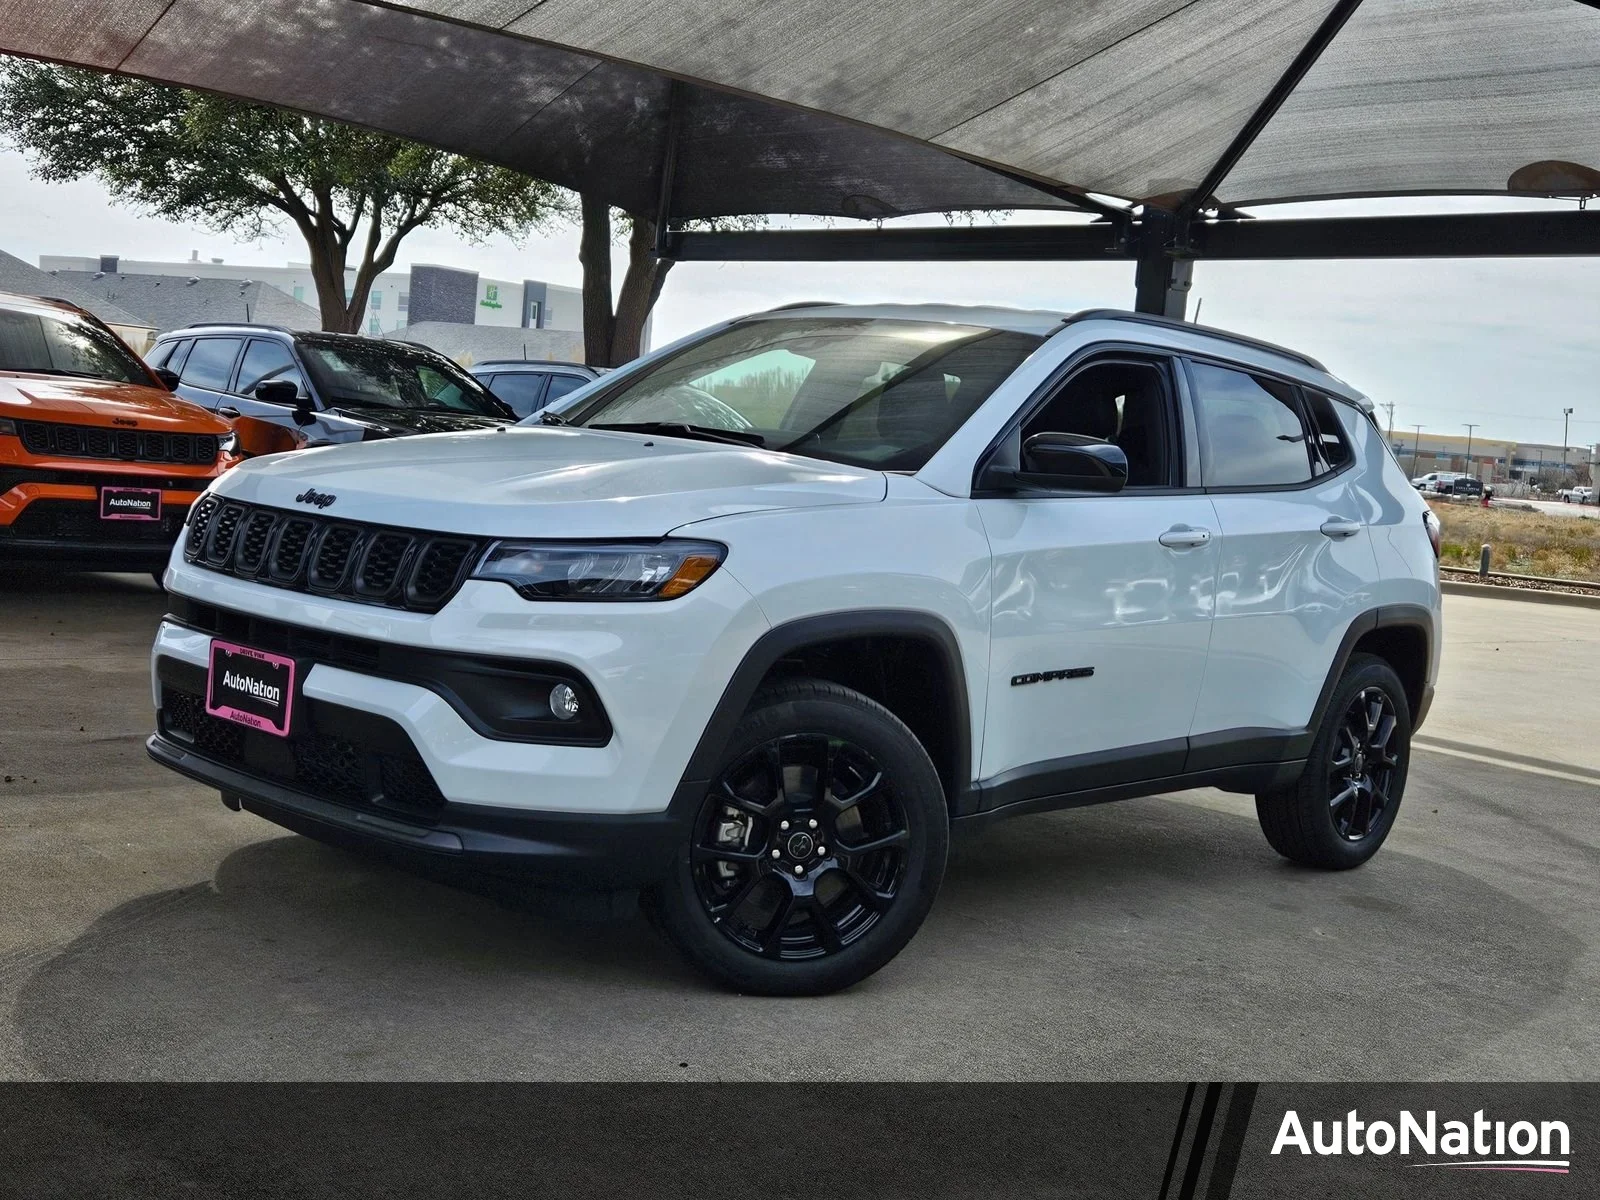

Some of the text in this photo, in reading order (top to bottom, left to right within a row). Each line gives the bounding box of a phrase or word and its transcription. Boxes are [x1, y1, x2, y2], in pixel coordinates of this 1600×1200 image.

[109, 498, 151, 507] AutoNation
[296, 488, 337, 509] Jeep
[223, 670, 280, 701] AutoNation
[1011, 667, 1095, 686] COMPASS
[230, 711, 261, 728] AutoNation
